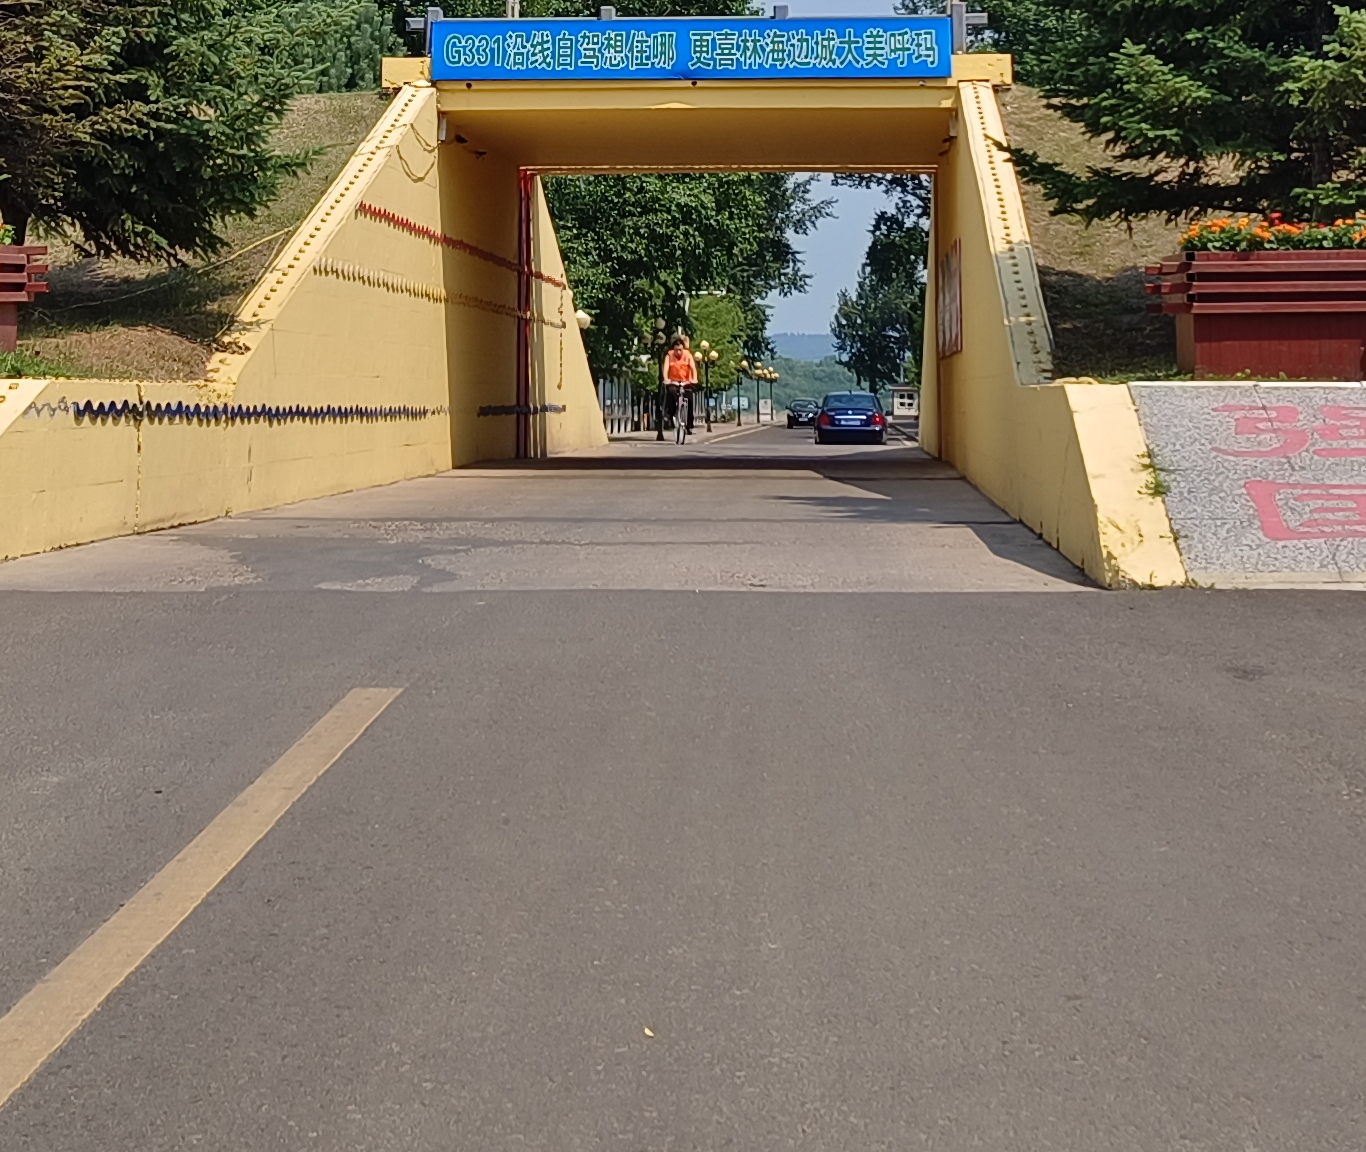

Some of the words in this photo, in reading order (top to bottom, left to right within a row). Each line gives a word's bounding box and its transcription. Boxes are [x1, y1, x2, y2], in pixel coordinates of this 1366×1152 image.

[443, 30, 677, 70] G331沿线自驾想住哪
[689, 28, 939, 70] 更喜林海边城大美呼玛
